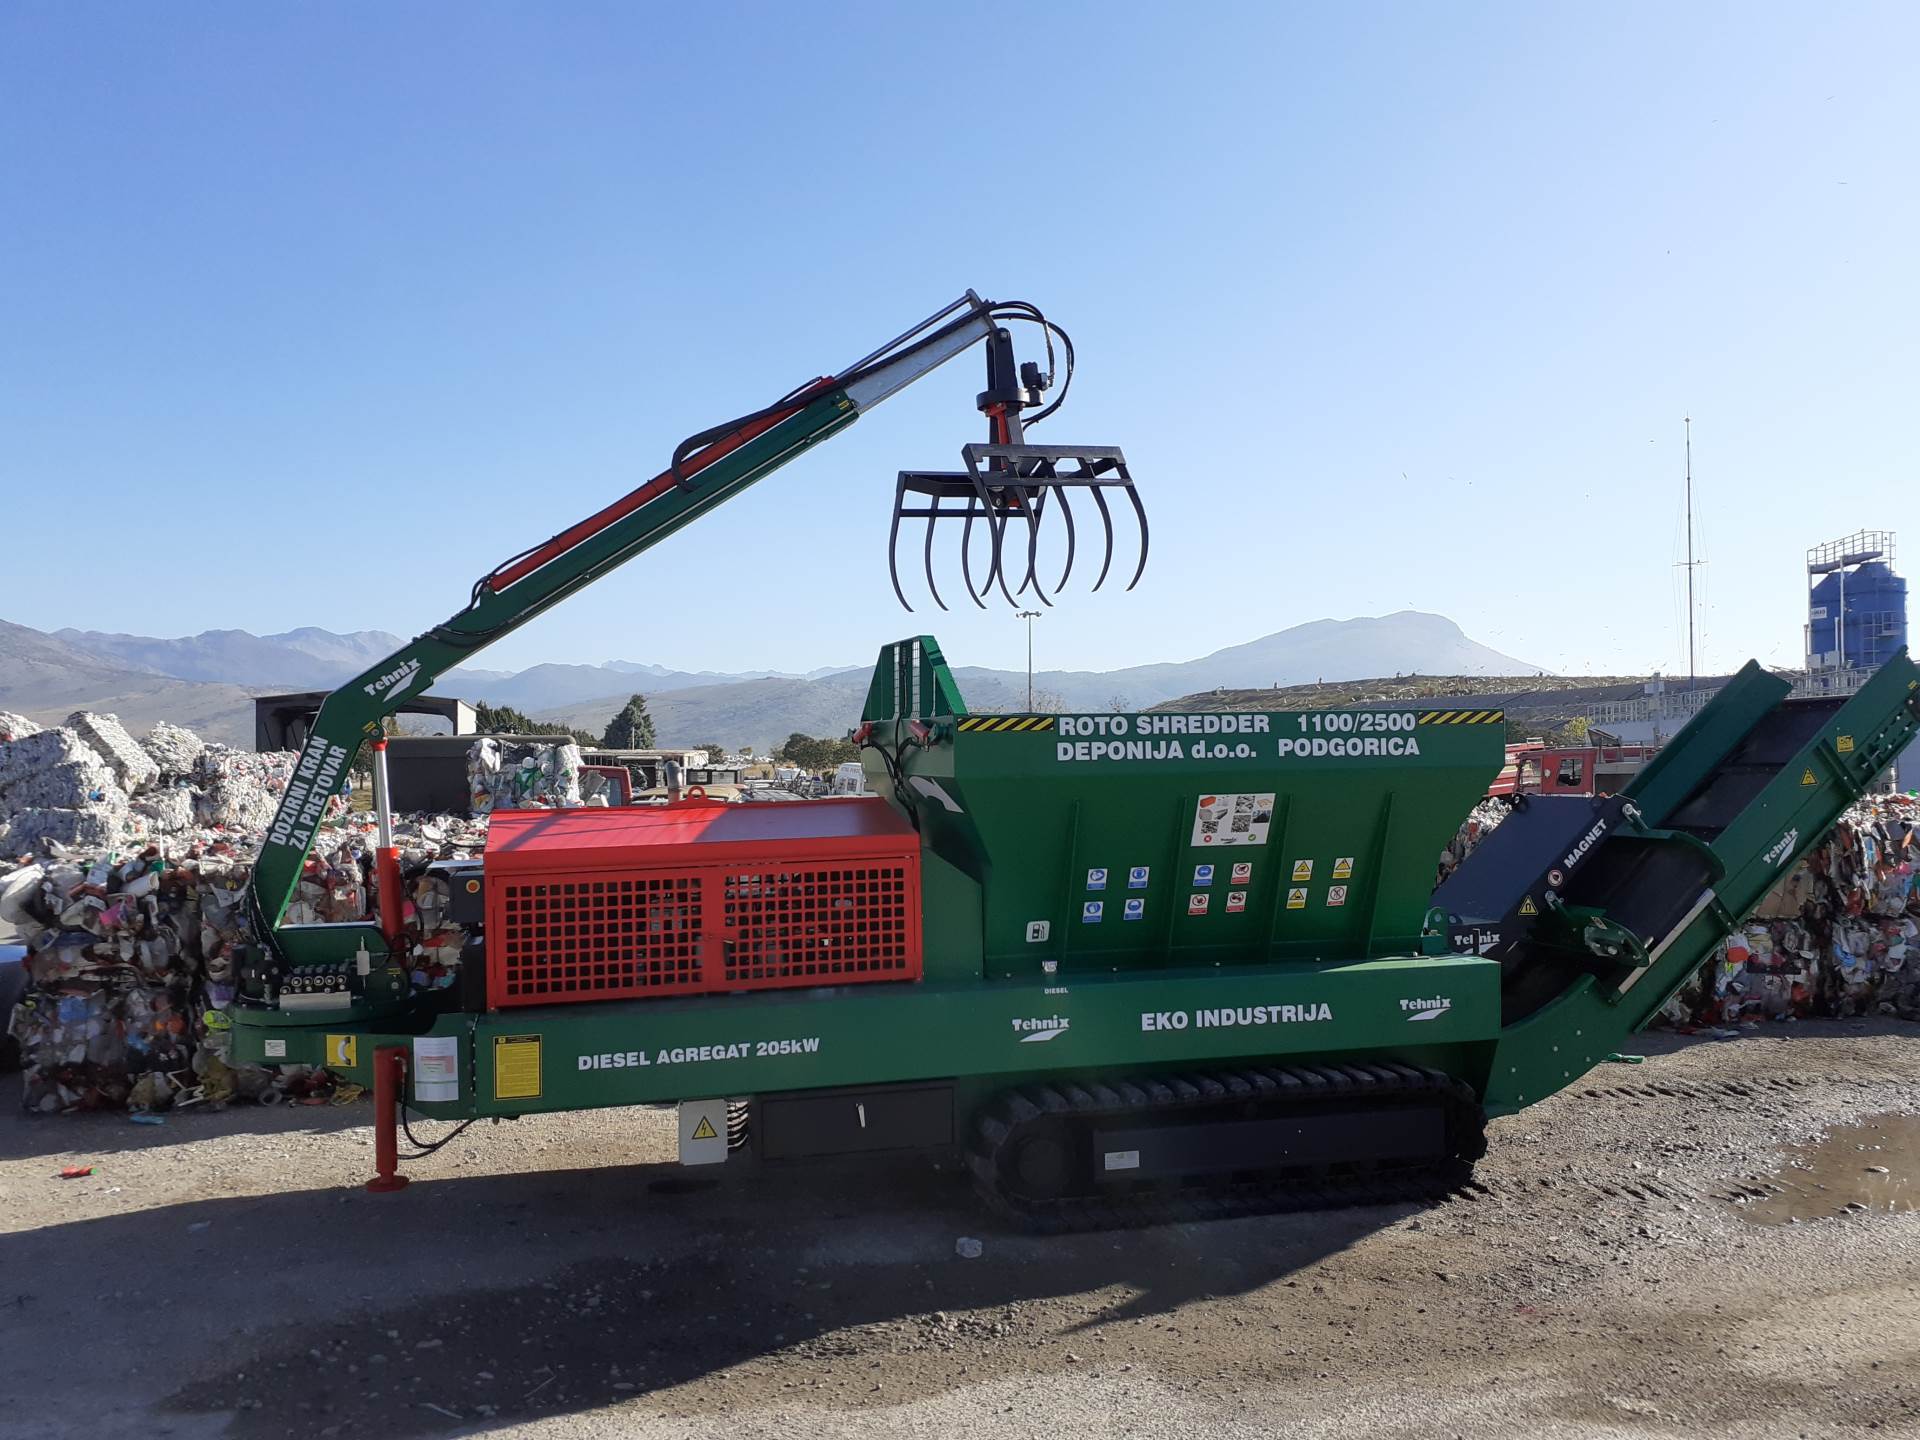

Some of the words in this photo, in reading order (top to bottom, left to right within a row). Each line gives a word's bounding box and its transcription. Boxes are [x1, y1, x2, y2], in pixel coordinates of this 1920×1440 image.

[363, 657, 422, 697] Tehnix
[1059, 715, 1128, 736] ROTO
[1136, 714, 1269, 735] SHREDDER
[1297, 712, 1416, 734] 1100/2500
[1057, 740, 1184, 761] DEPONIJA
[1191, 740, 1257, 759] d.o.o.
[1278, 737, 1420, 757] PODGORICA
[268, 780, 310, 846] DOZIRNI
[297, 735, 329, 779] KRAN
[288, 829, 312, 851] ZA
[300, 745, 348, 827] PRETOVAR
[1563, 818, 1607, 869] MAGNET
[1762, 827, 1799, 864] Tehnix
[1044, 987, 1068, 995] DIESEL
[1399, 995, 1452, 1011] Tehnix
[1012, 1014, 1070, 1031] Tehnix
[1141, 1011, 1189, 1031] EKO
[1196, 1003, 1333, 1028] INDUSTRIJA
[578, 1051, 651, 1071] DIESEL
[656, 1042, 750, 1065] AGREGAT
[756, 1038, 820, 1056] 205kW
